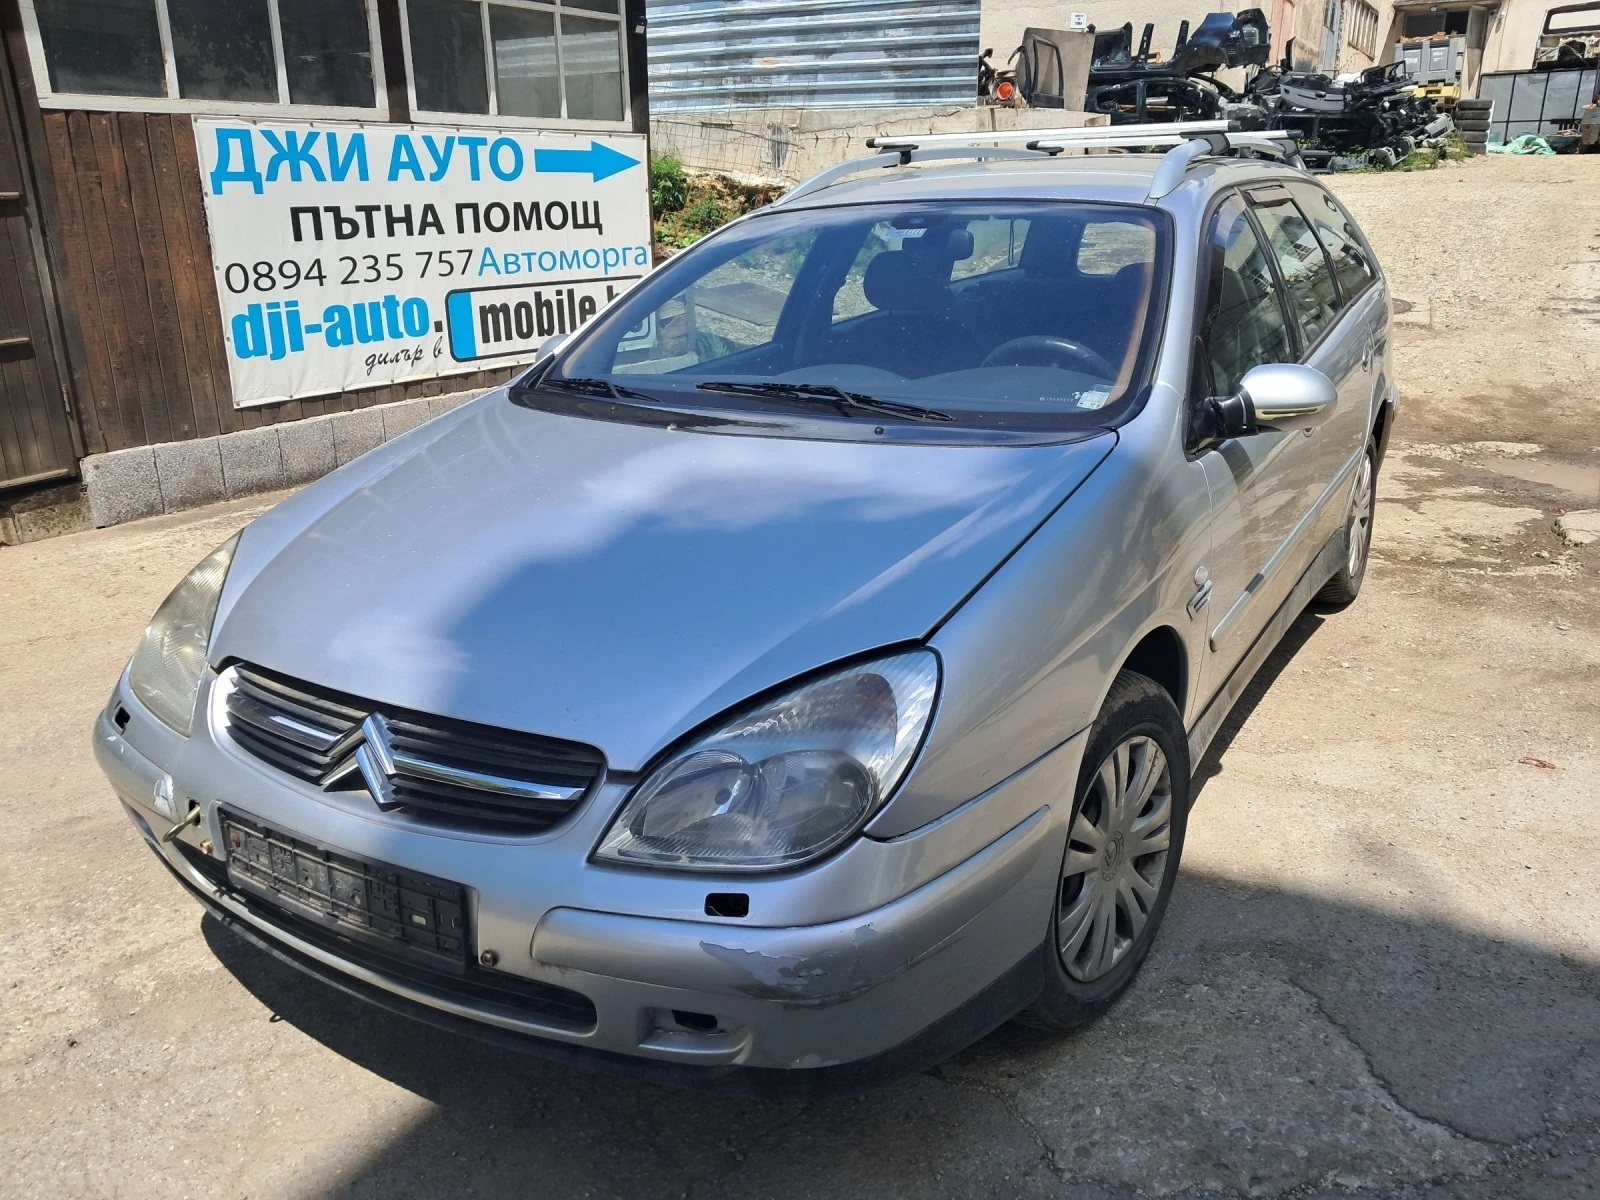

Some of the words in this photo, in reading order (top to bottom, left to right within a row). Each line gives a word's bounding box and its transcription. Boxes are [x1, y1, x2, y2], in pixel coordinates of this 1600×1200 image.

[210, 128, 370, 195] ДЖИ
[387, 134, 524, 182] АУТО
[290, 203, 445, 242] ПЪТНА
[455, 200, 603, 235] ПОМОЩ
[224, 258, 328, 294] 0894
[338, 253, 404, 285] 235
[415, 249, 473, 279] 757
[477, 245, 648, 275] Автоморга
[365, 345, 424, 376] дилър
